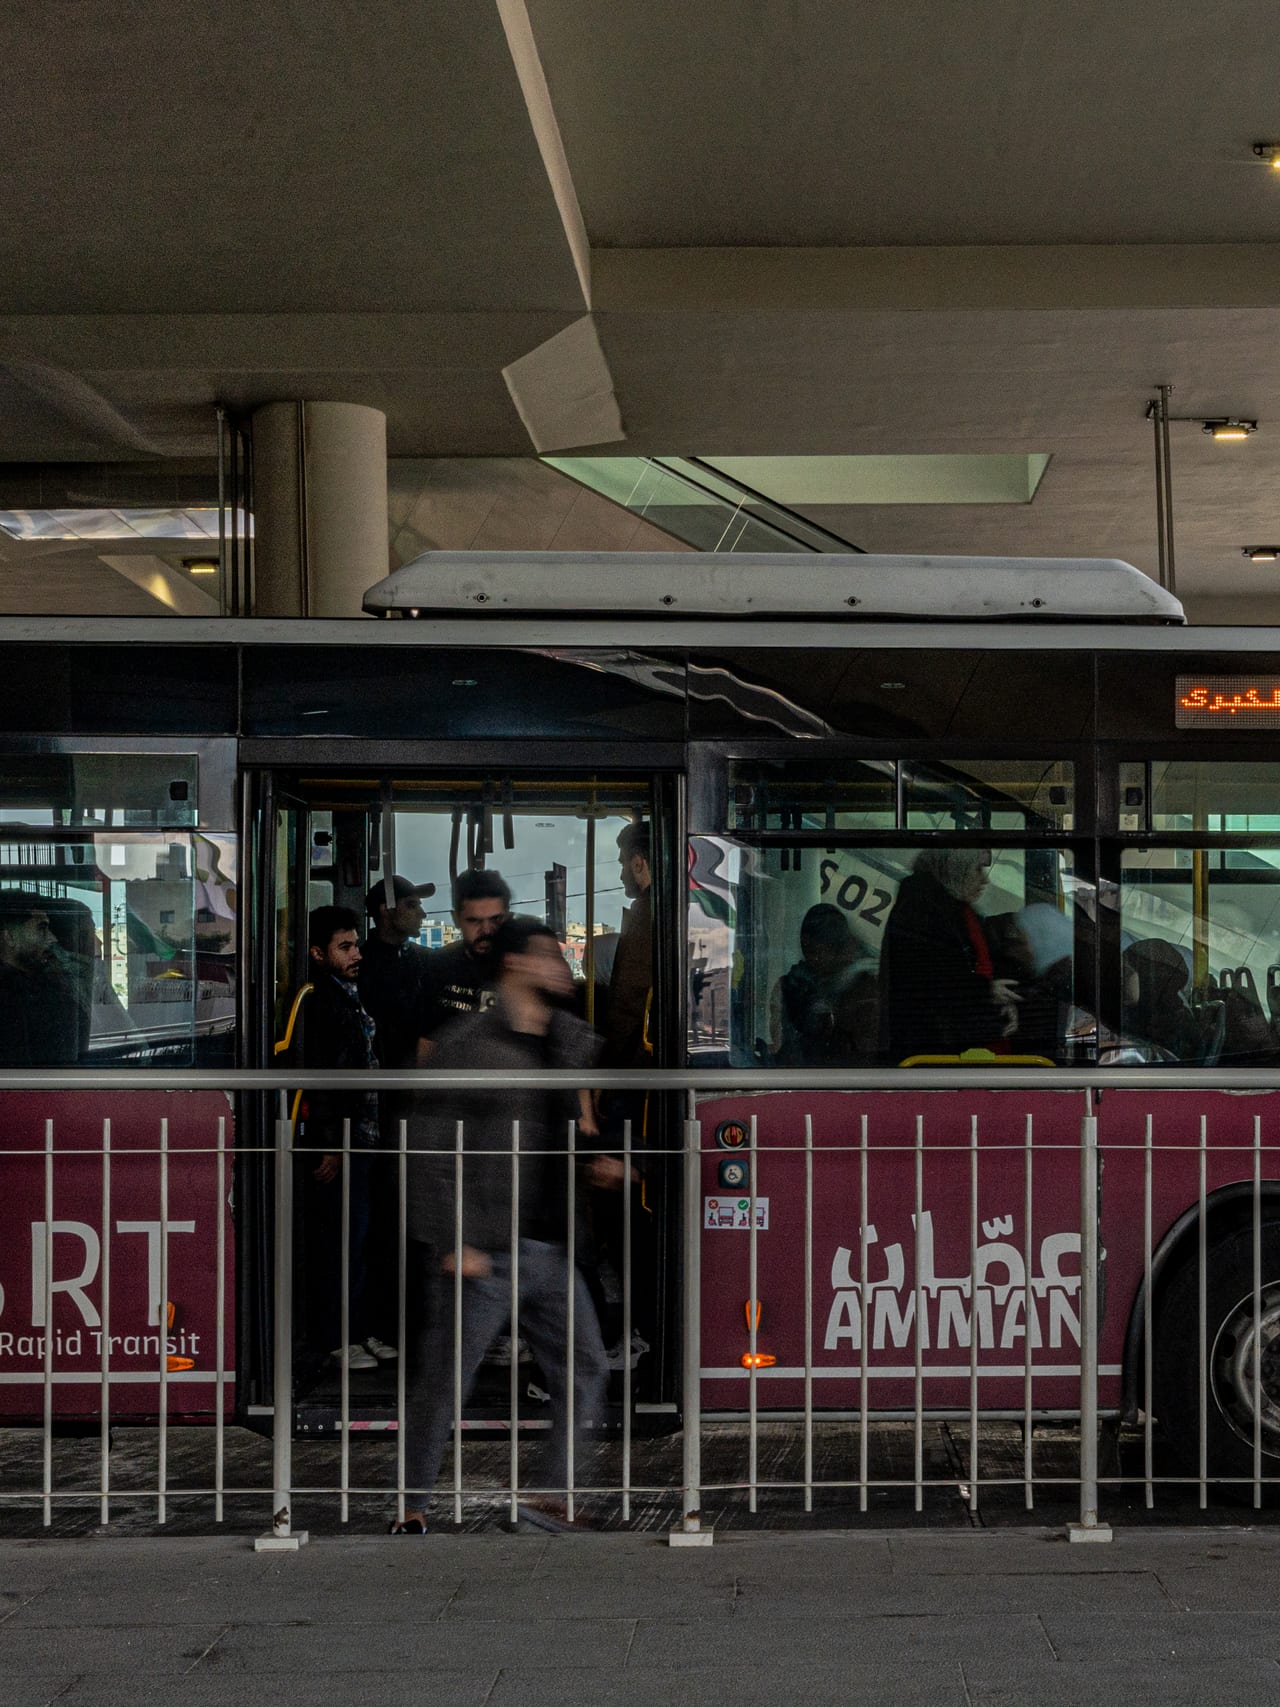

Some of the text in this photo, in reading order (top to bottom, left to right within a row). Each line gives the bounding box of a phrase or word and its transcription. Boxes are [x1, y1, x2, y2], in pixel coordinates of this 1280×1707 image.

[0, 1220, 195, 1328] RT
[0, 1328, 201, 1359] Rapid Transit
